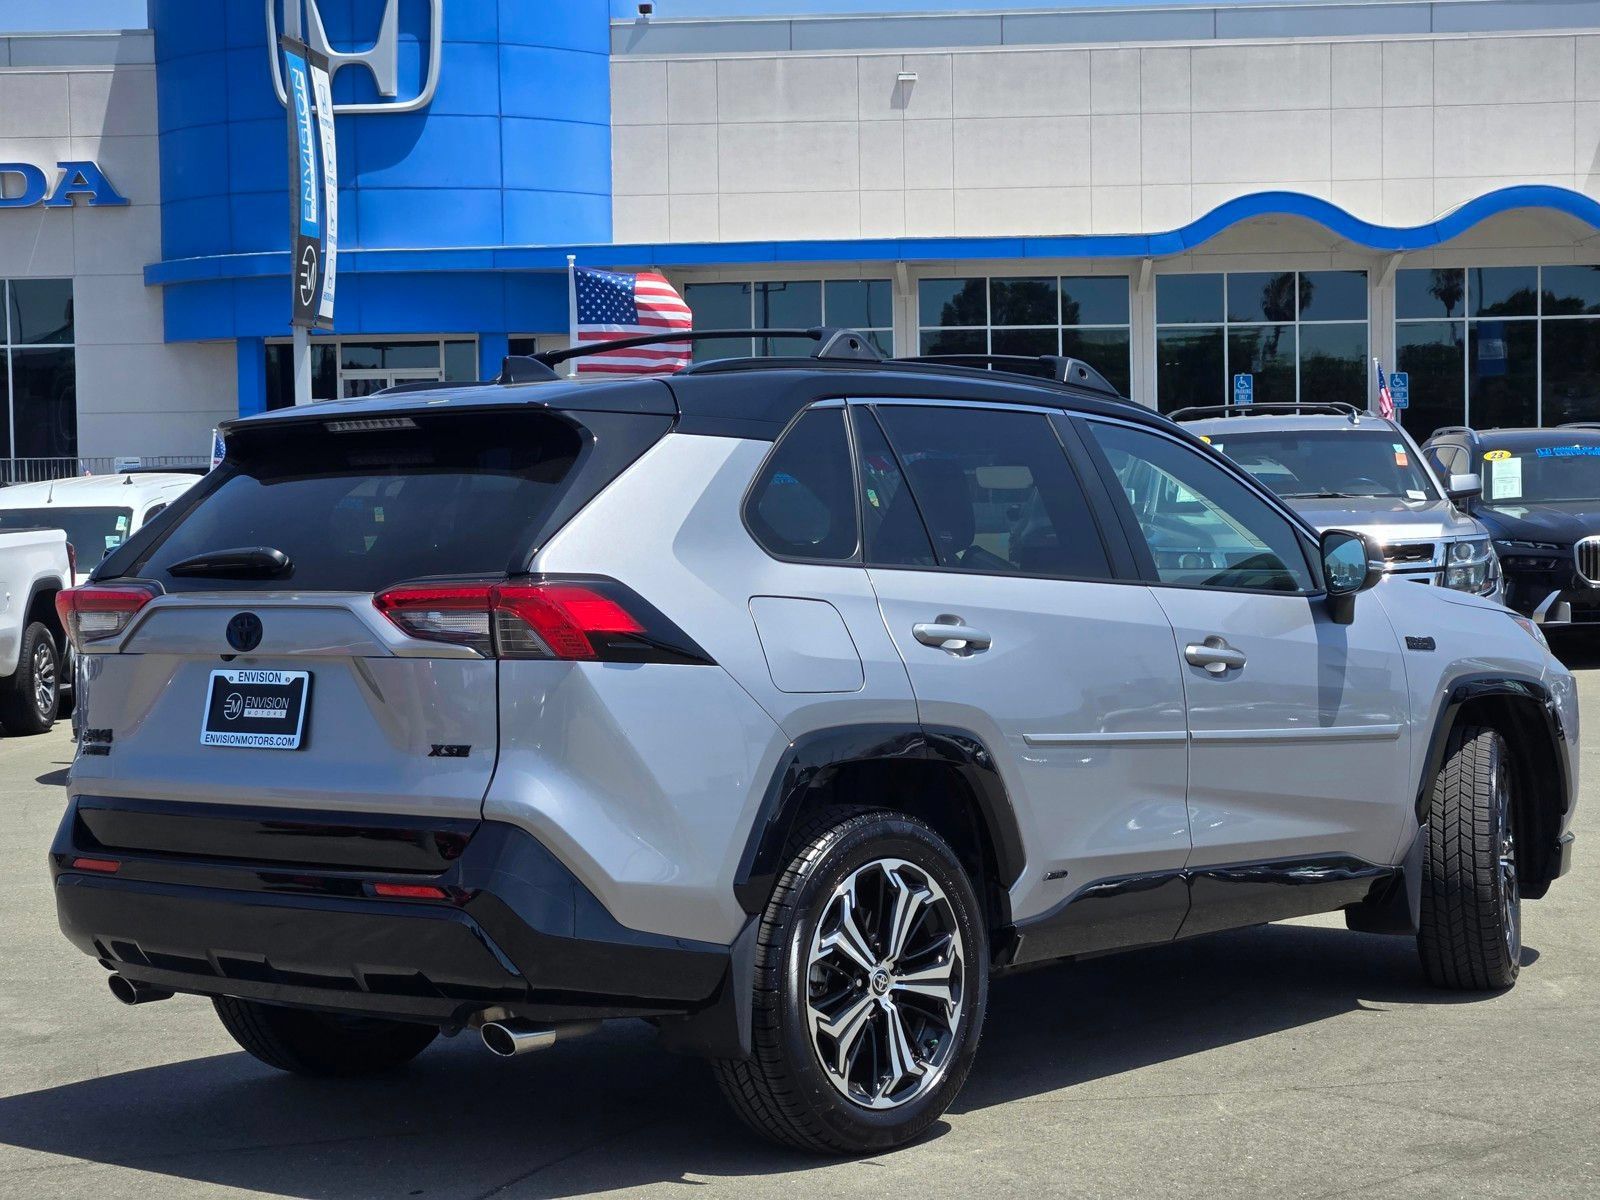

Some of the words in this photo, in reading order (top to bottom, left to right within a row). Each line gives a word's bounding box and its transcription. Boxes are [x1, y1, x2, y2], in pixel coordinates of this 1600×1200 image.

[292, 67, 318, 224] ENVISION
[1491, 451, 1504, 459] 23
[238, 672, 281, 682] ENVISION
[245, 697, 289, 708] ENVISION
[205, 734, 295, 746] ENVISIONMOTORS.COM
